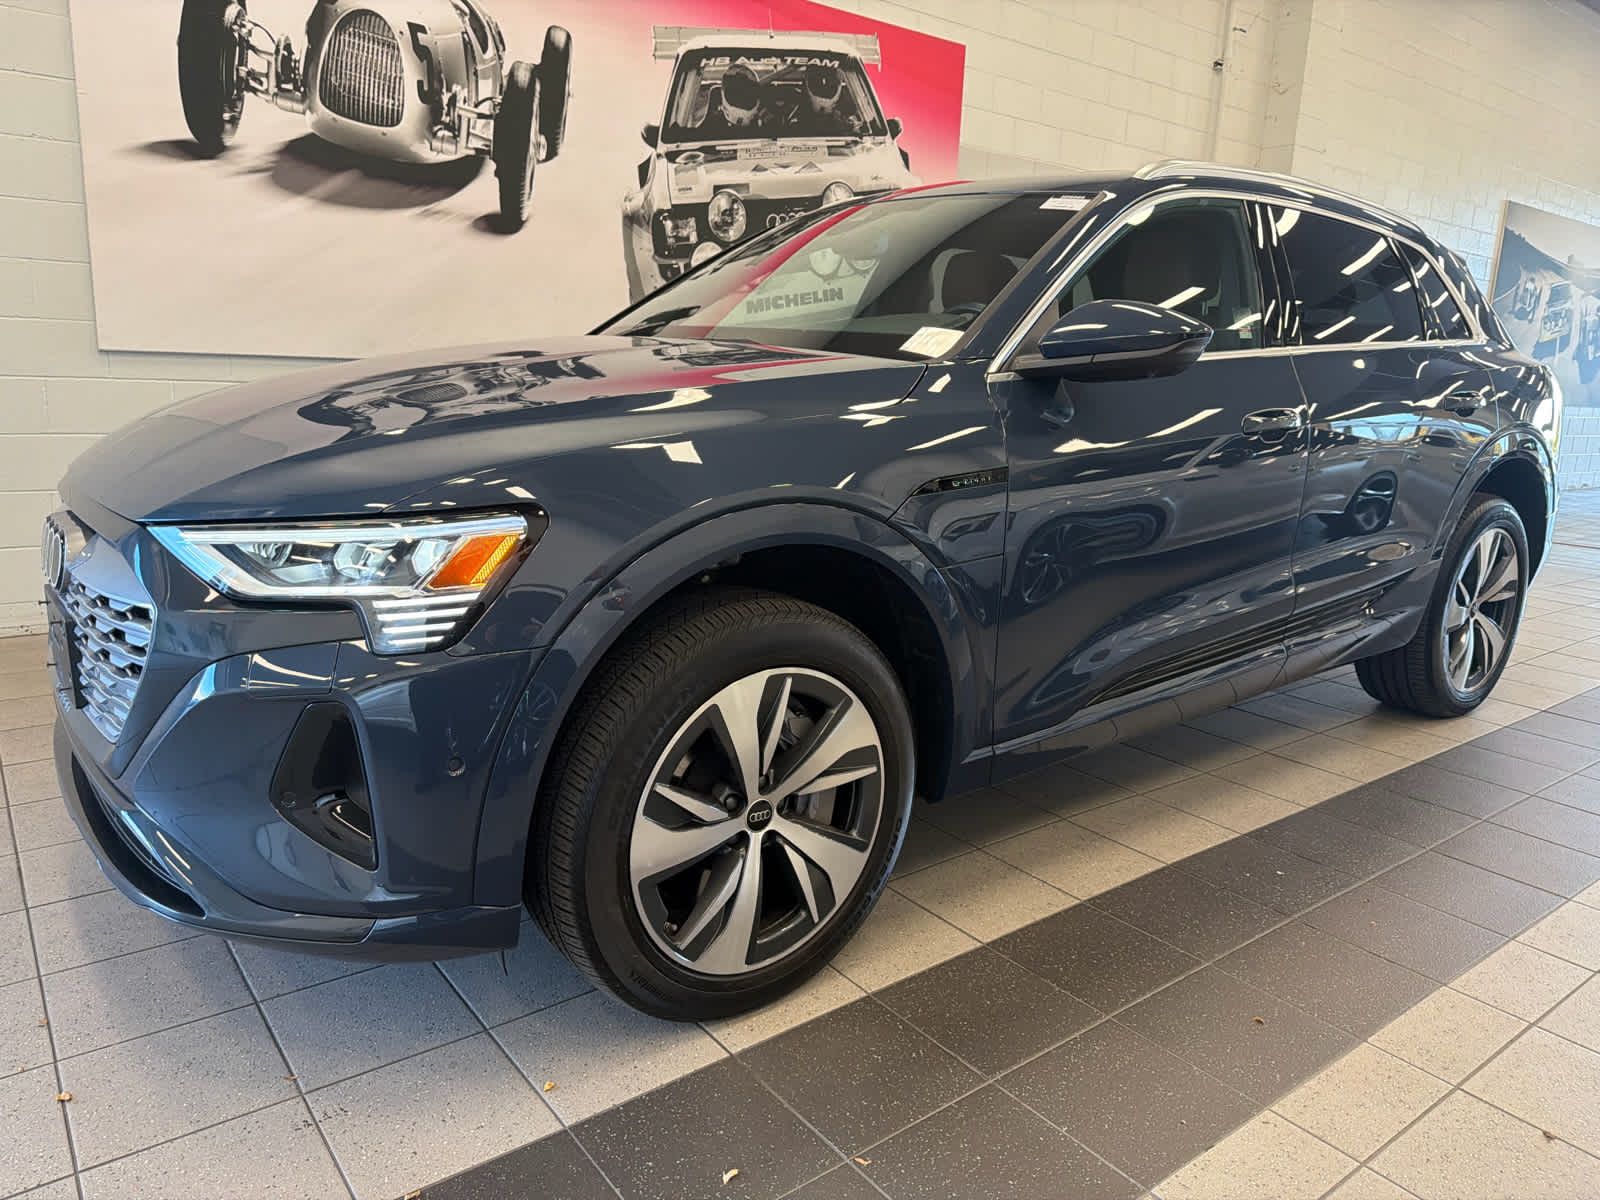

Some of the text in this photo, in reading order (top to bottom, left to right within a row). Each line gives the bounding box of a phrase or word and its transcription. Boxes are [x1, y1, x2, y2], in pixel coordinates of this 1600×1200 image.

[406, 21, 434, 105] 5
[700, 56, 730, 68] HB
[783, 56, 840, 68] TEAM
[746, 287, 844, 314] MICHELIN
